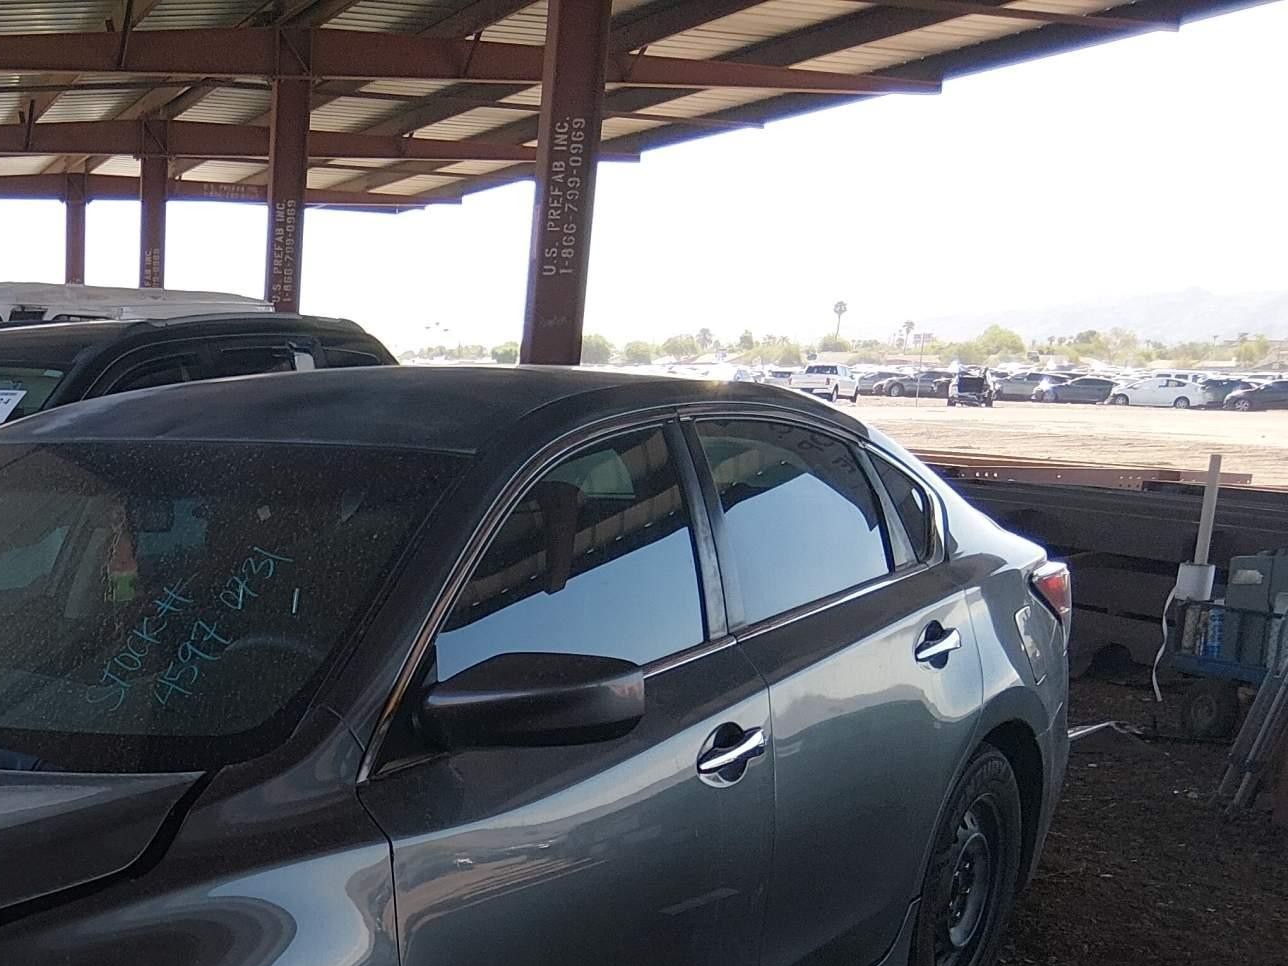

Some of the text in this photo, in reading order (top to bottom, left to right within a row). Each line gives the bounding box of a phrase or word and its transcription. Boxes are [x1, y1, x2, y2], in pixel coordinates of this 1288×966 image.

[275, 199, 286, 222] INC.
[542, 116, 571, 277] U.S. PREFAB INC.
[559, 117, 586, 275] 1-866-799-0969
[272, 227, 284, 275] PREFAB
